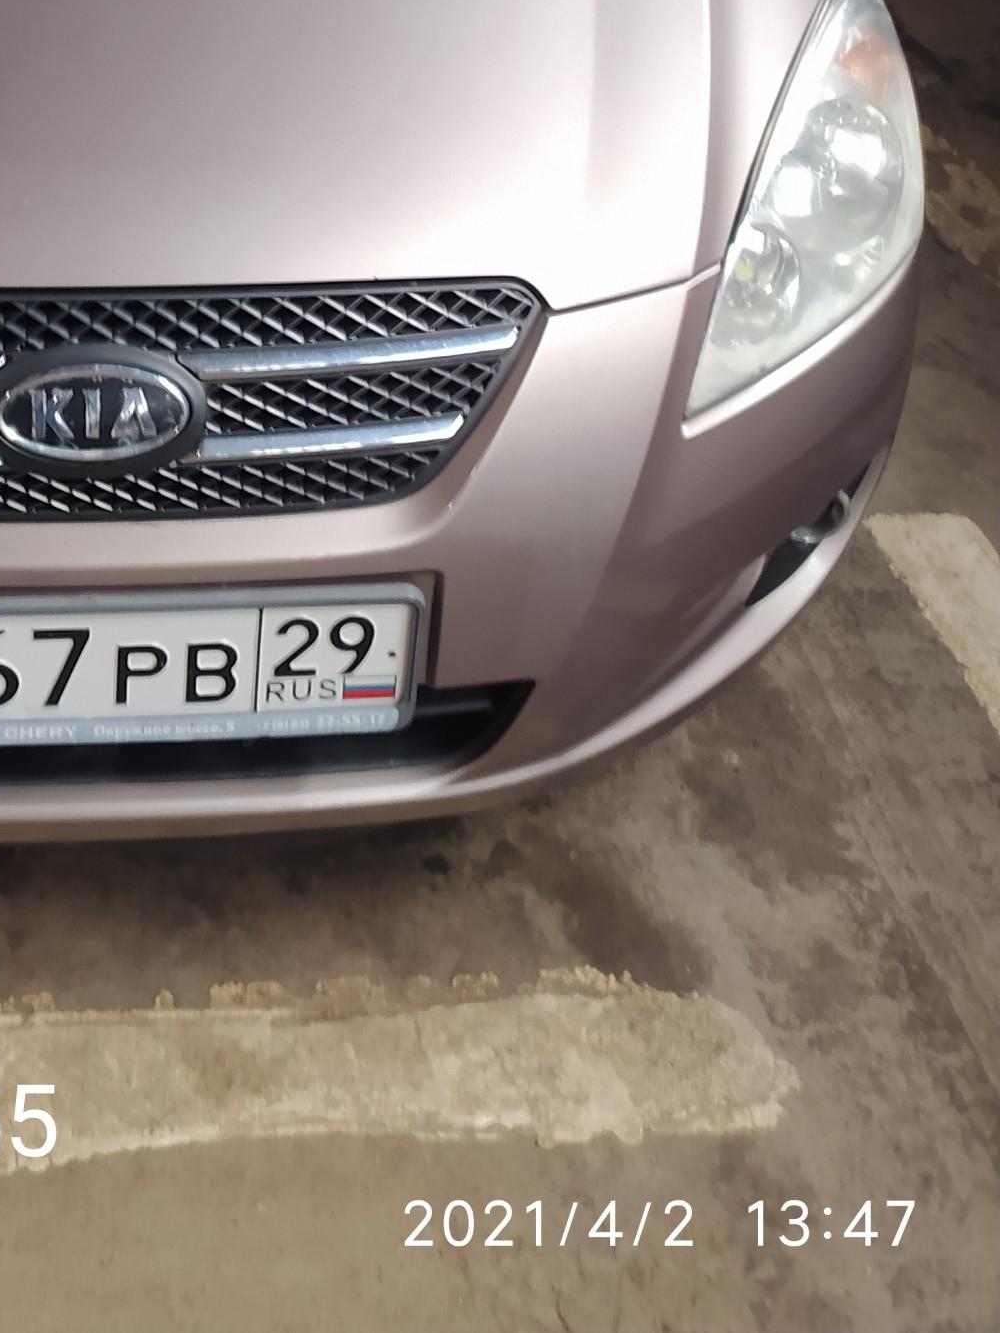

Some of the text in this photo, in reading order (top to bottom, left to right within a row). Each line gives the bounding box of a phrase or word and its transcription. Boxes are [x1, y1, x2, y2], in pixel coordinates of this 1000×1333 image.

[29, 387, 157, 441] KIA
[274, 616, 375, 677] 29
[266, 679, 337, 703] RUS
[4, 725, 76, 740] CHERY
